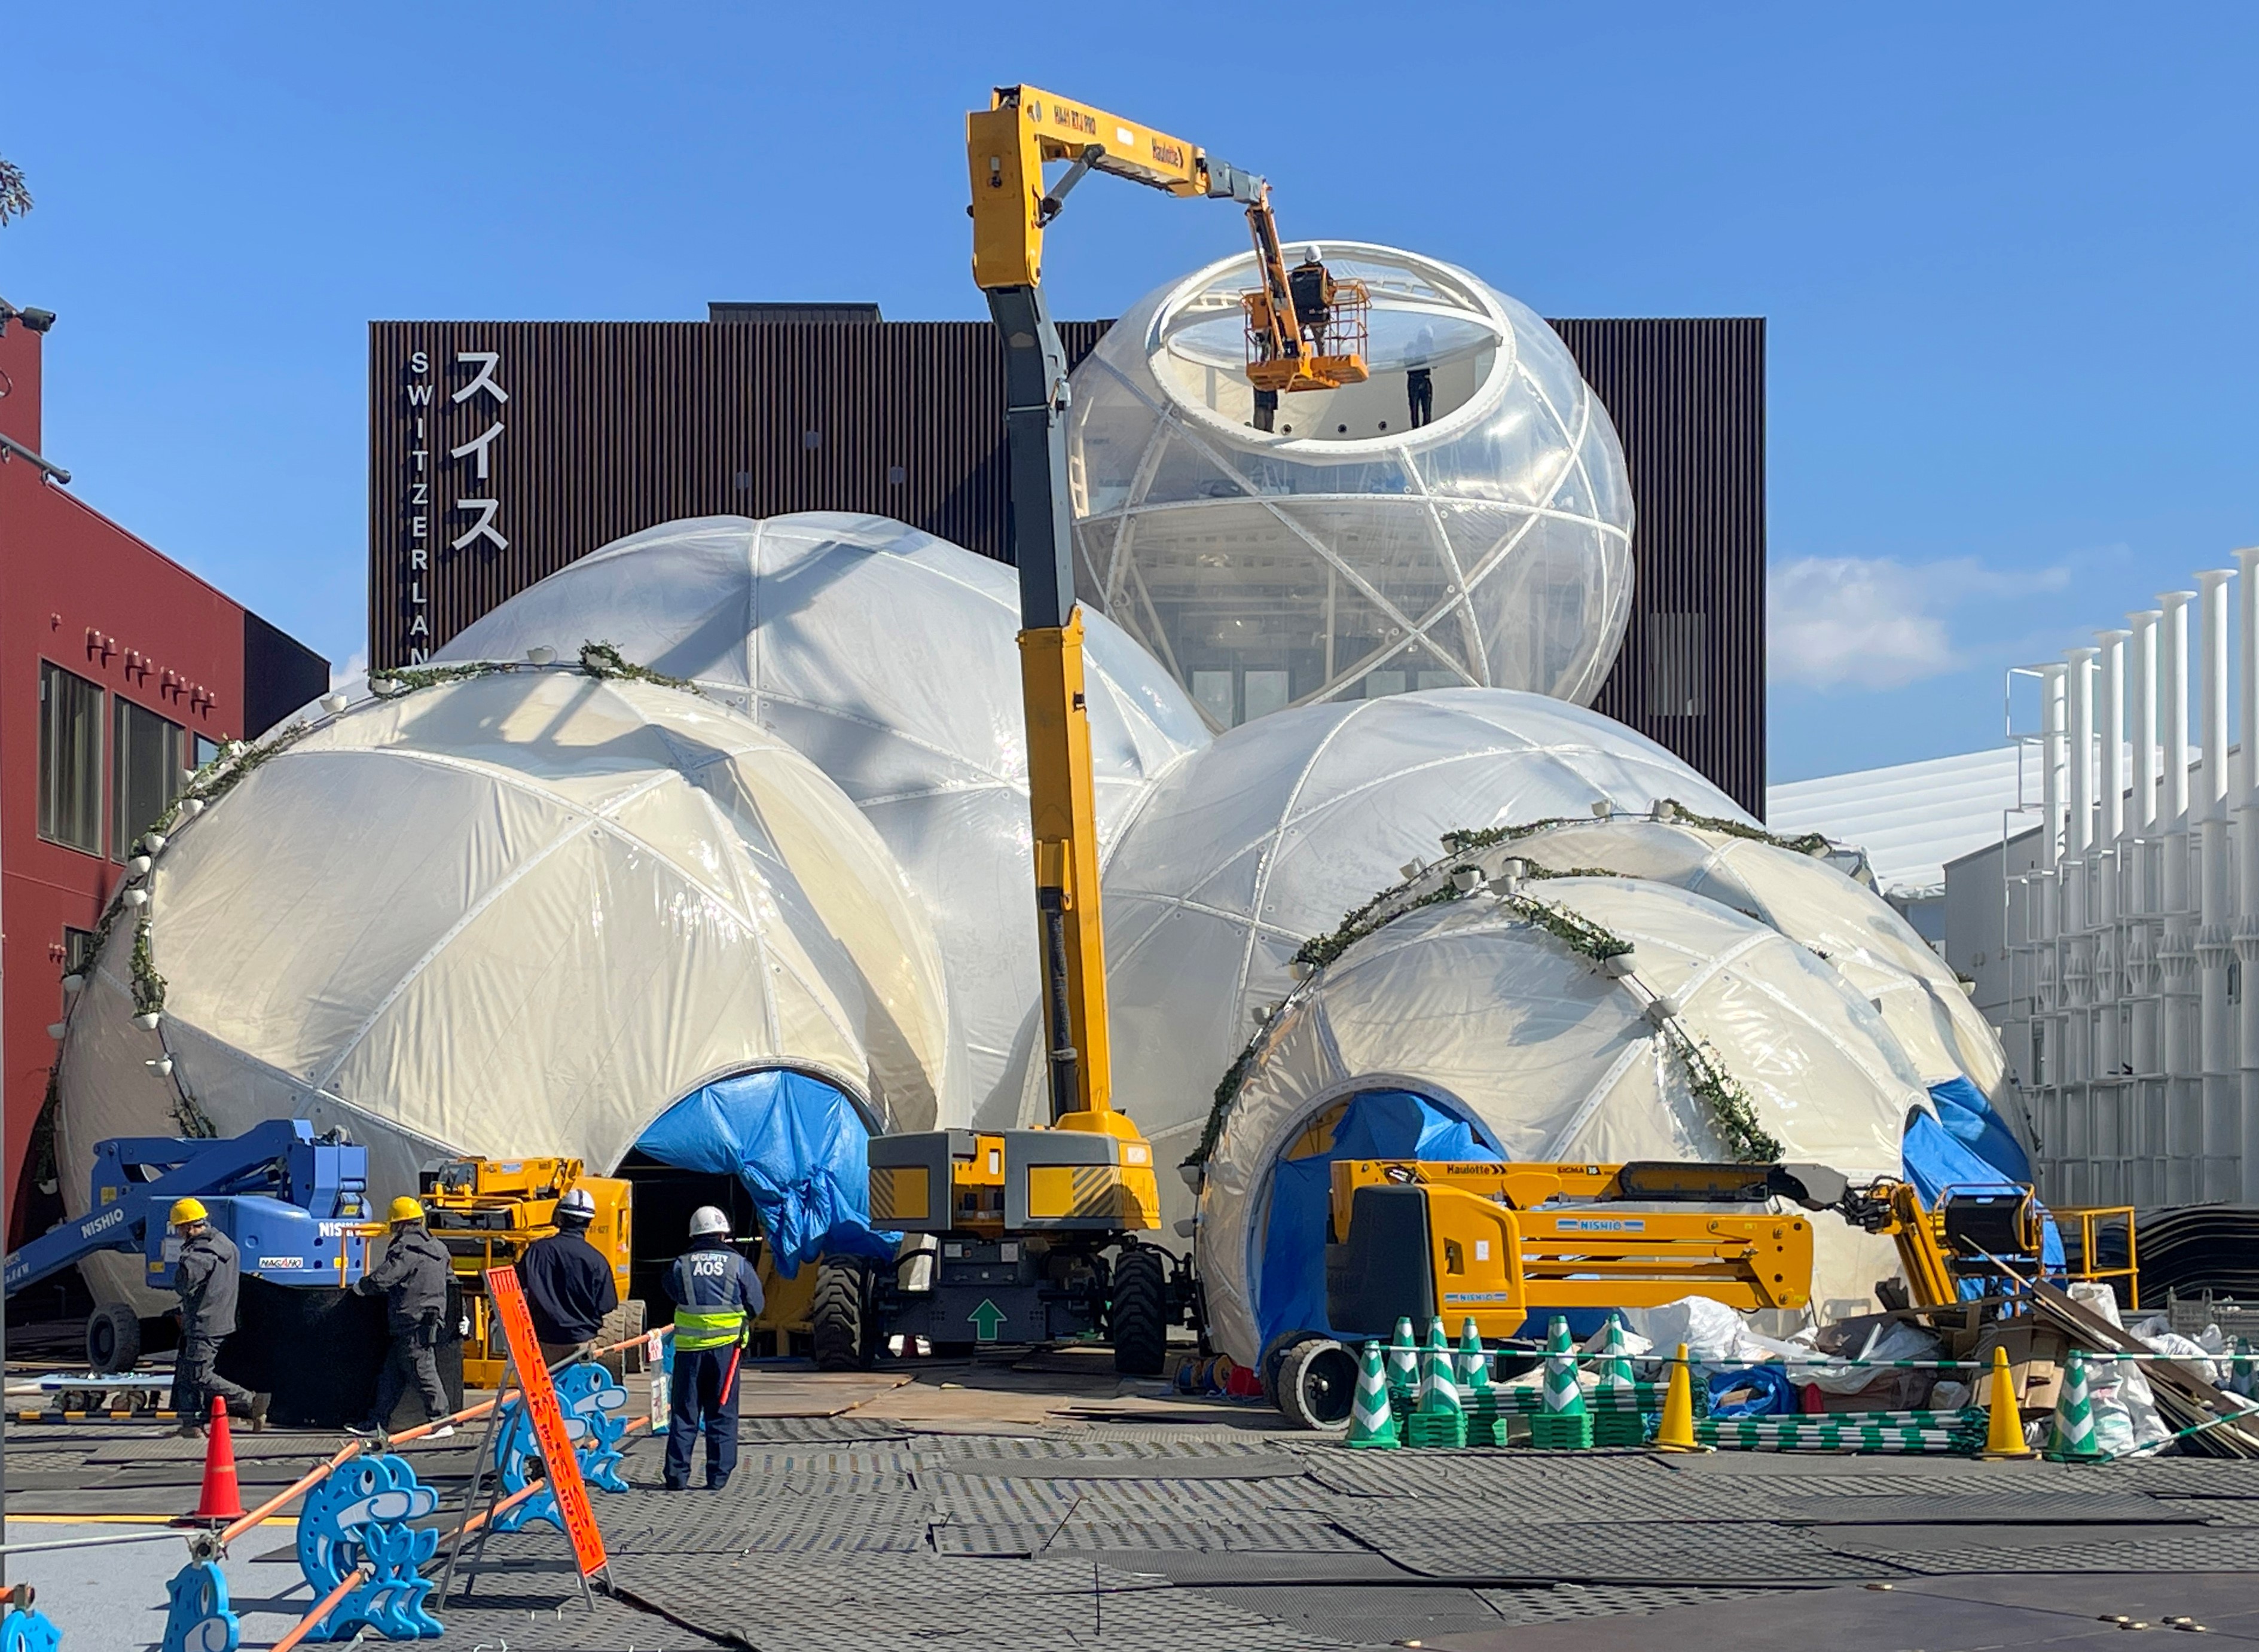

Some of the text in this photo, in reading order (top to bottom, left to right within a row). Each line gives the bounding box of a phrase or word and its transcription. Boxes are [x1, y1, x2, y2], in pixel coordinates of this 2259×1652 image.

[451, 350, 509, 551] スイス
[407, 352, 432, 665] SWITZERLAN
[1446, 1164, 1489, 1174] Haulotte
[80, 1207, 124, 1239] NISHIO
[1580, 1220, 1622, 1230] NISHIO
[690, 1253, 728, 1262] SECURITY
[692, 1262, 724, 1276] AOS
[1460, 1293, 1493, 1302] NISHIO
